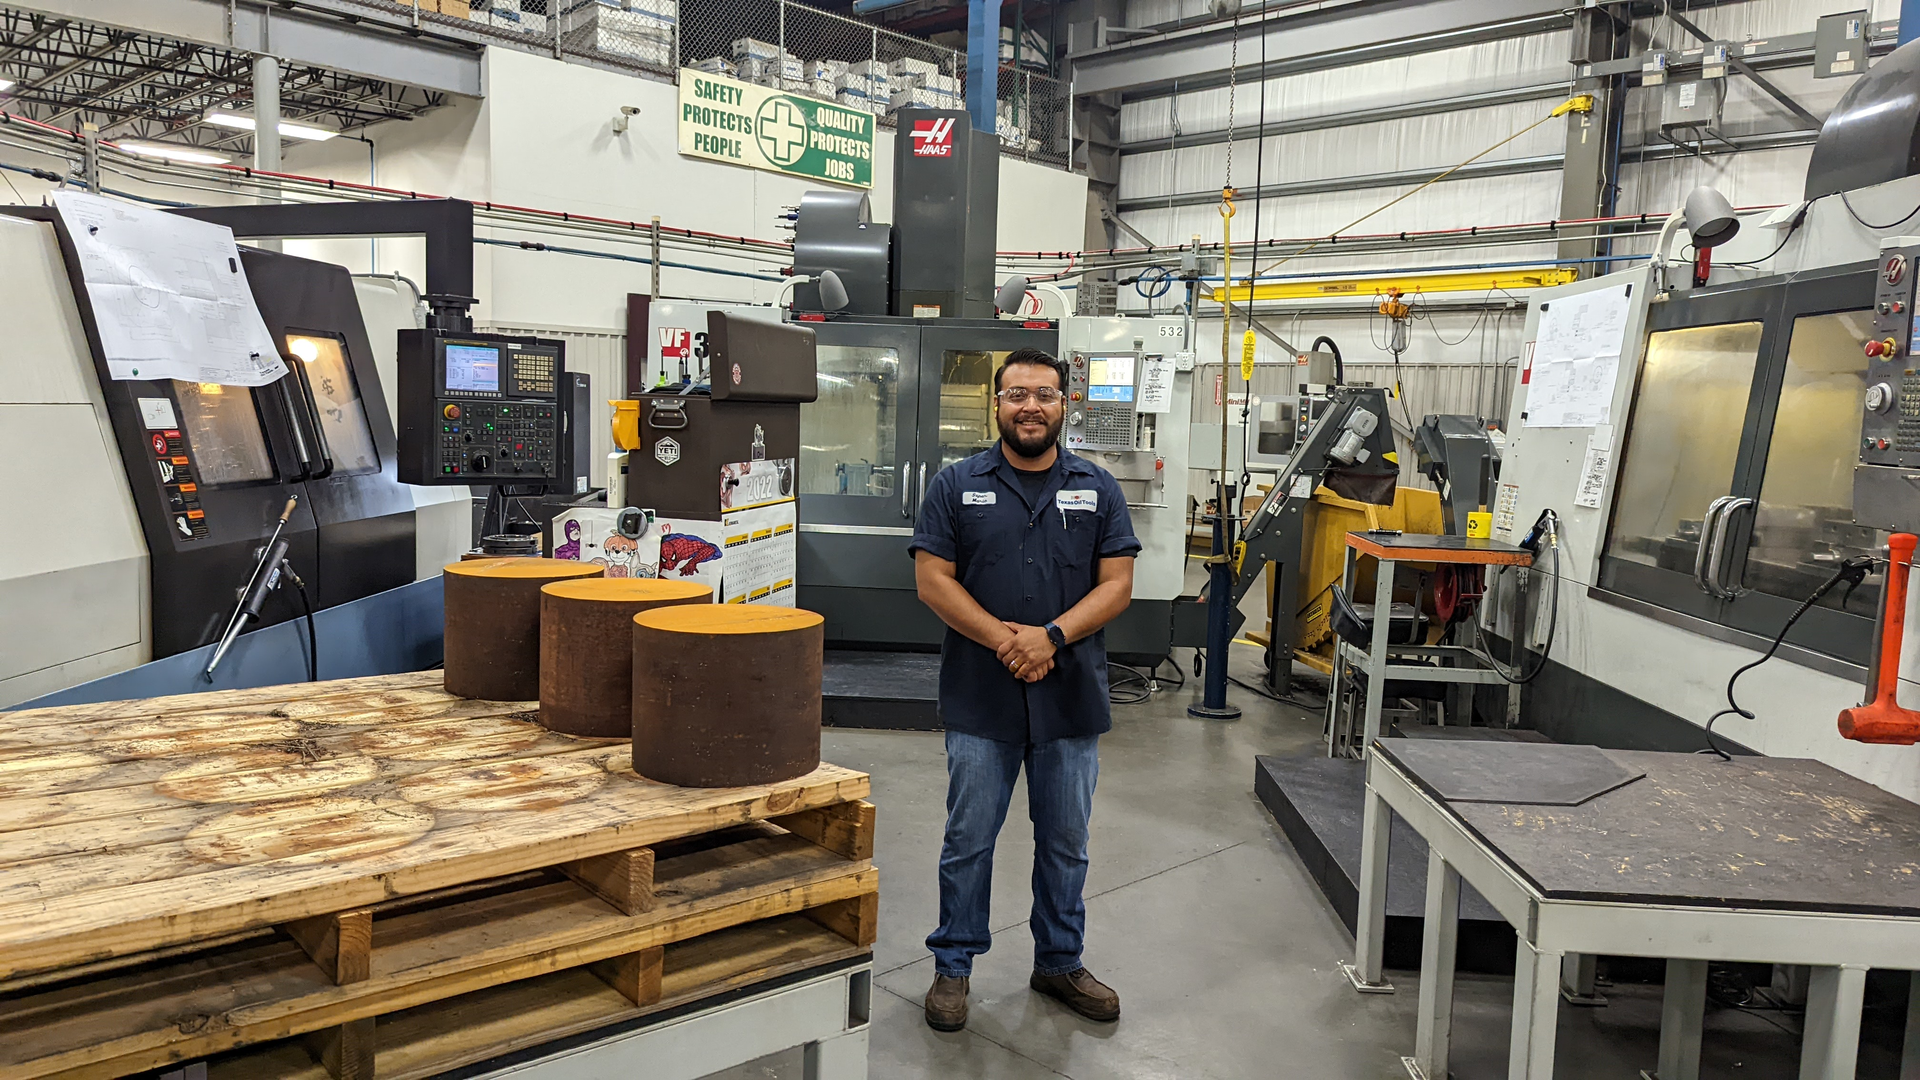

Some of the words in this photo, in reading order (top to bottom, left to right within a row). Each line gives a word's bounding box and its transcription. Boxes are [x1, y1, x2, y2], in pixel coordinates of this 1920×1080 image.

[694, 78, 743, 106] SAFETY
[683, 103, 753, 135] PROTECTS
[816, 107, 866, 134] QUALITY
[694, 132, 742, 159] PEOPLE
[810, 130, 870, 160] PROTECTS
[914, 144, 952, 155] HAAS
[824, 158, 855, 181] JOBS
[659, 328, 687, 348] VF
[1160, 326, 1183, 337] 532
[746, 474, 773, 501] 2022
